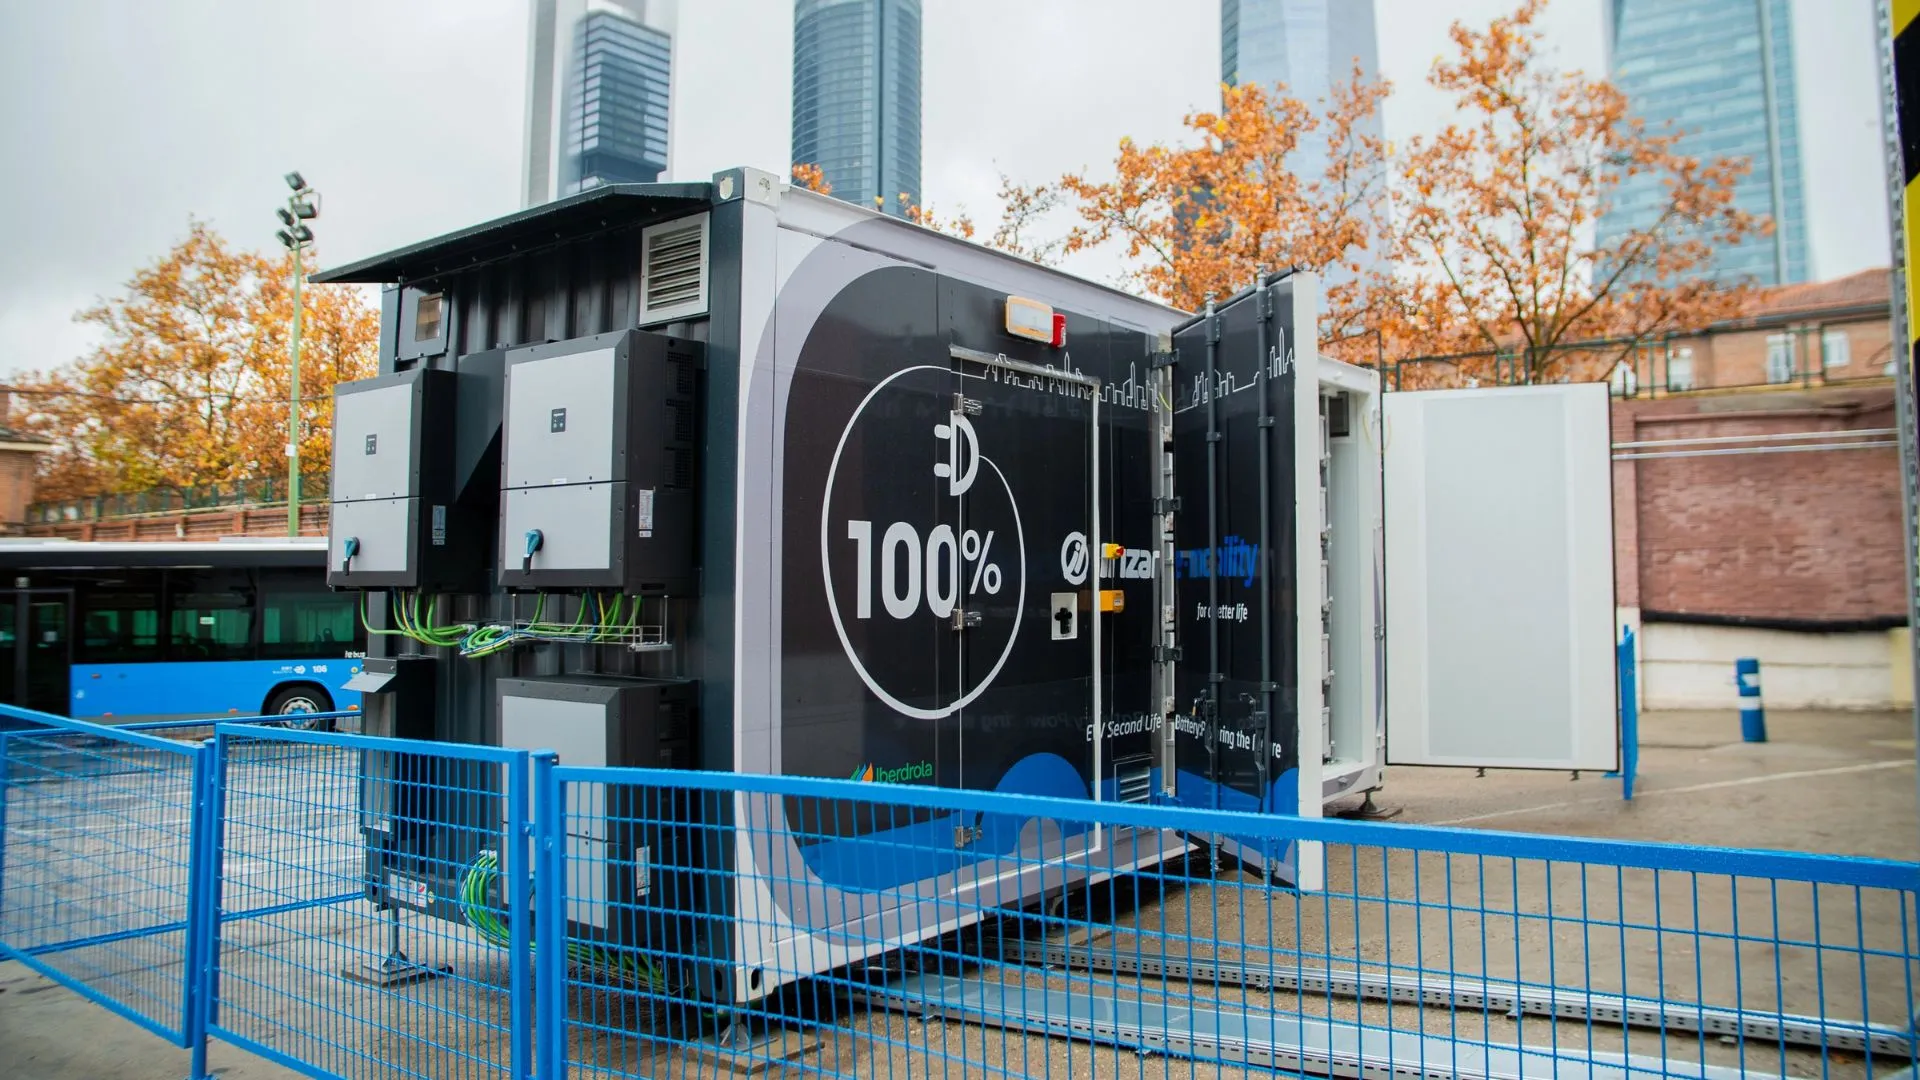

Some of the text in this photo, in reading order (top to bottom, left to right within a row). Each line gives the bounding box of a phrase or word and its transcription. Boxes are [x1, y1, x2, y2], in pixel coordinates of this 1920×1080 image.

[848, 520, 1002, 620] 100%
[1196, 602, 1207, 621] for
[1214, 604, 1235, 619] etter
[1236, 603, 1248, 623] life
[1107, 714, 1143, 738] Second
[1145, 712, 1162, 733] Life
[1236, 729, 1250, 751] the
[876, 760, 933, 783] Iberdrola
